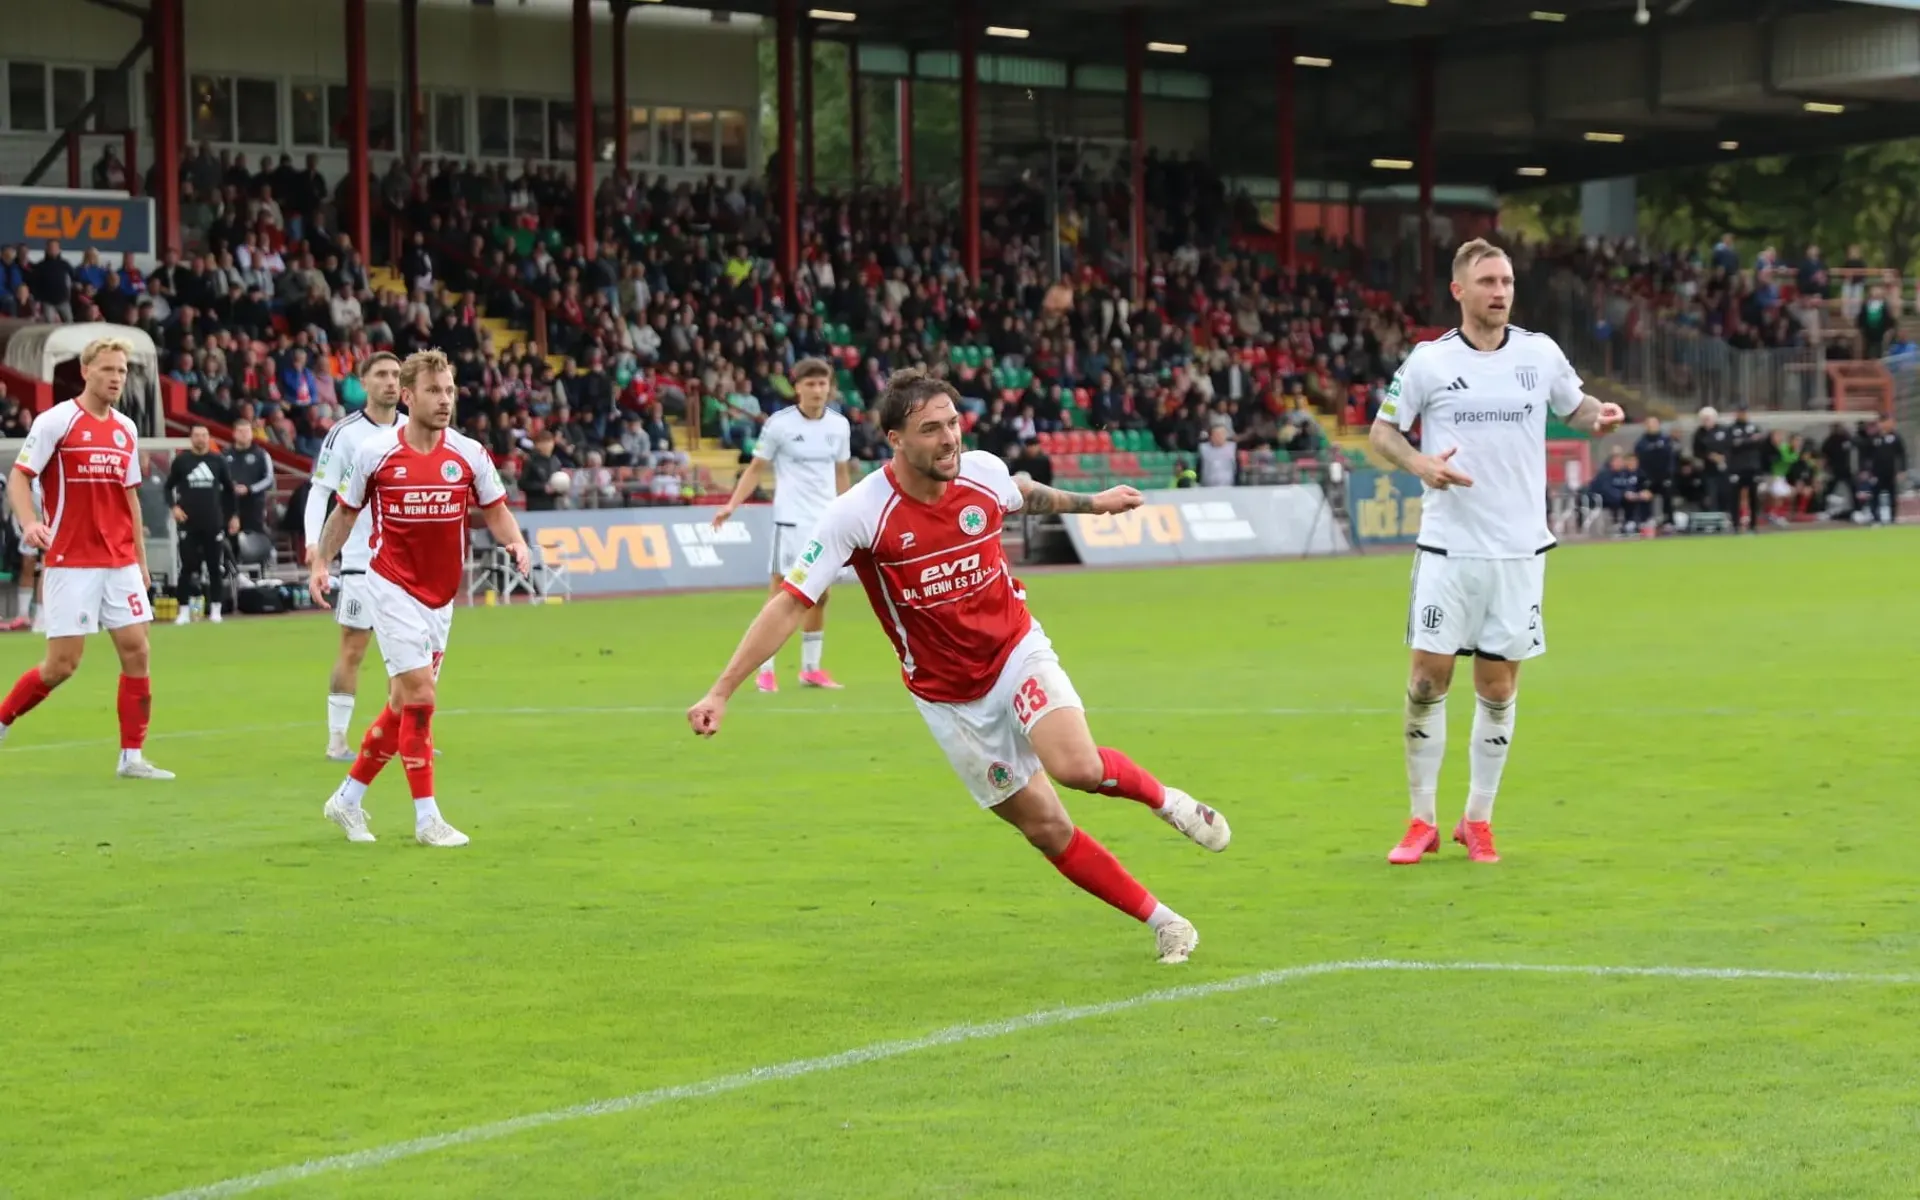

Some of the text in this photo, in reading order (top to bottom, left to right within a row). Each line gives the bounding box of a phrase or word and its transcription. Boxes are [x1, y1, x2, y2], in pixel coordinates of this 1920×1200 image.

[24, 204, 122, 240] evo
[1454, 408, 1523, 425] praemium
[403, 491, 452, 503] evo
[404, 505, 427, 515] WENN
[429, 505, 439, 514] ES
[1077, 503, 1184, 547] evo
[536, 523, 672, 574] evo
[920, 553, 980, 583] evo
[902, 588, 922, 601] DA,
[923, 579, 953, 598] WENN
[954, 575, 969, 589] ES
[127, 592, 144, 617] 5
[1013, 677, 1048, 725] 23
